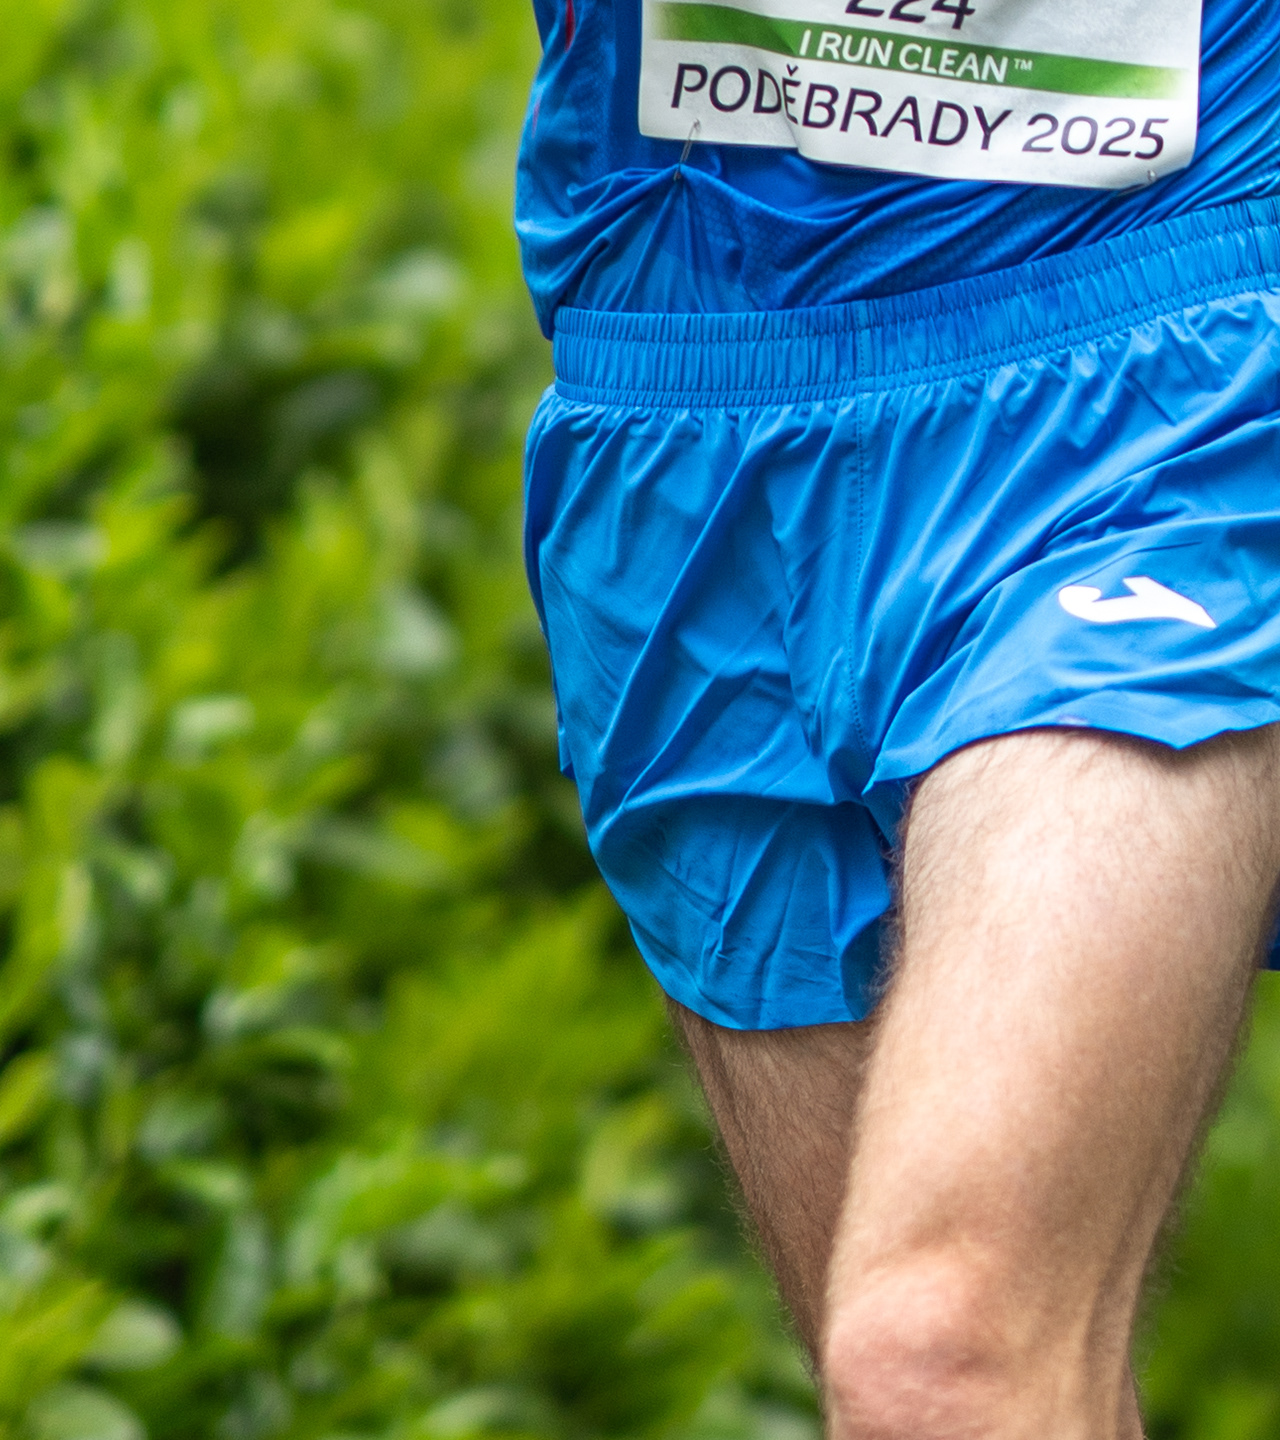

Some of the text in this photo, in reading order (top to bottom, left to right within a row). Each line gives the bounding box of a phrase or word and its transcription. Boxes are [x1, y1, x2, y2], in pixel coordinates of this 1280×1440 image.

[799, 28, 812, 57] I
[816, 31, 894, 67] RUN
[1021, 113, 1170, 160] 2025
